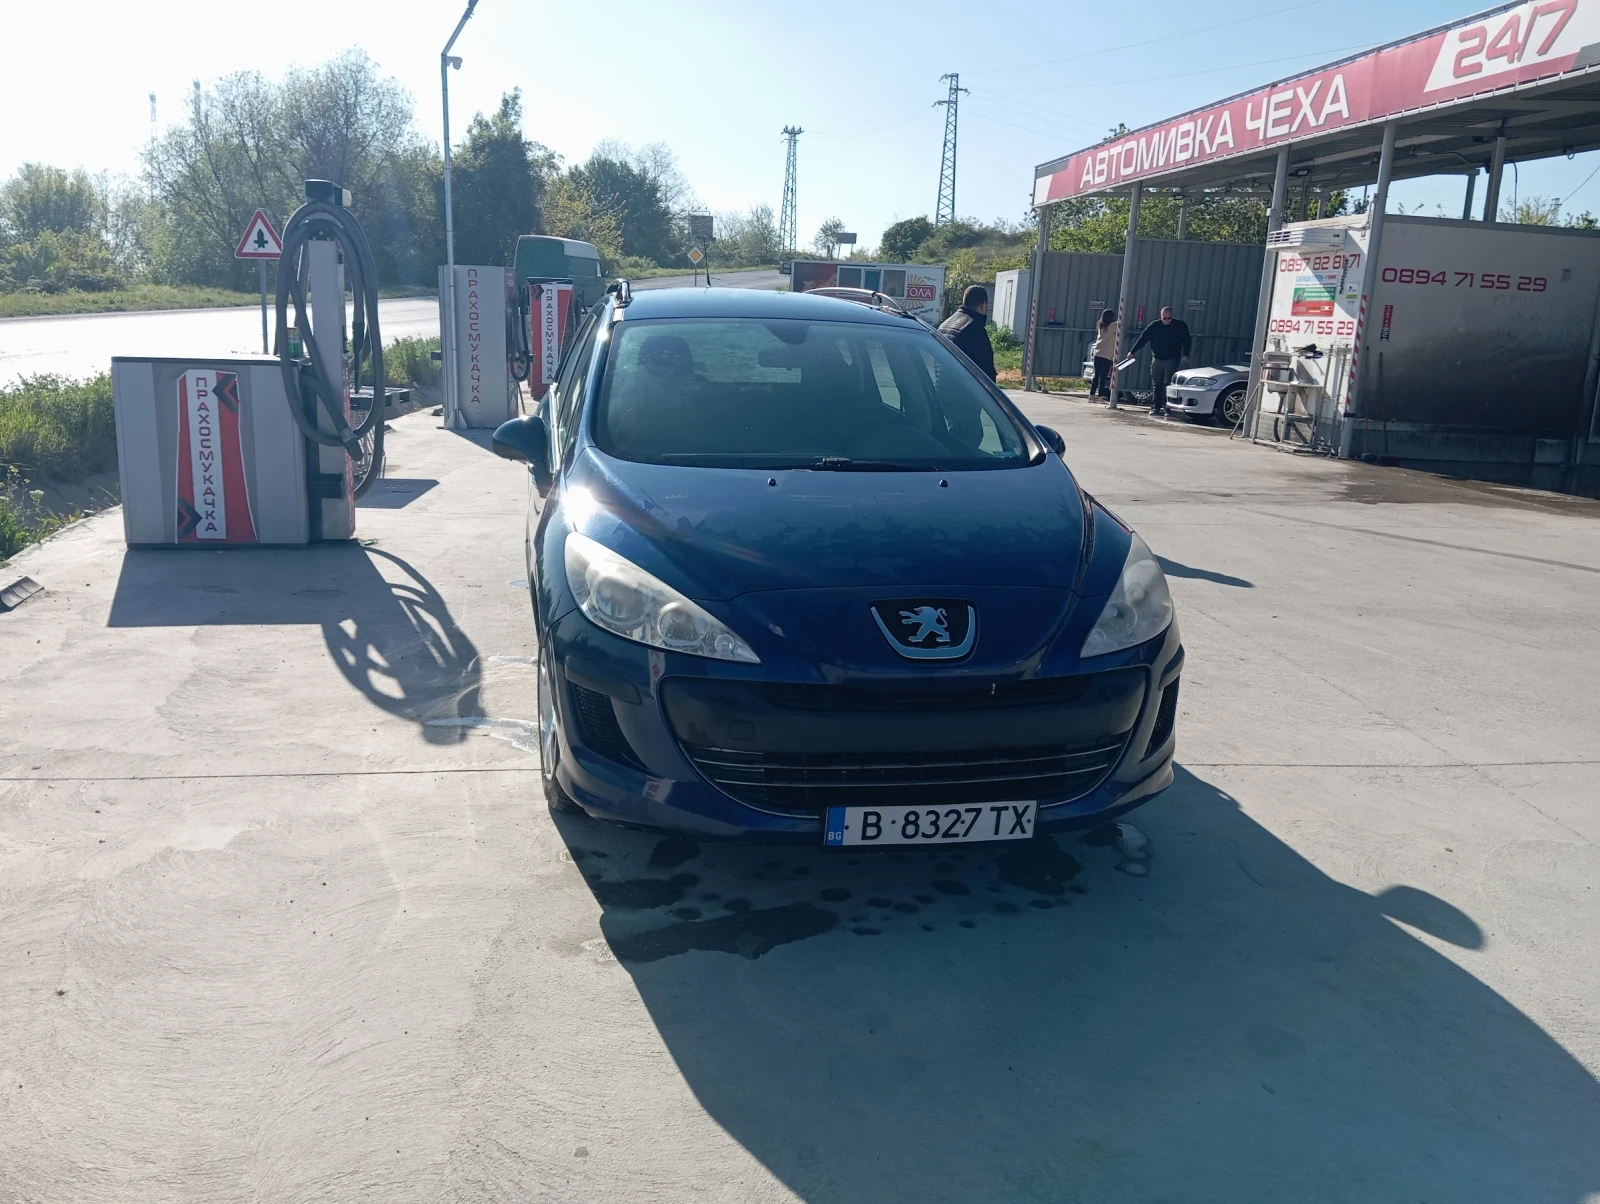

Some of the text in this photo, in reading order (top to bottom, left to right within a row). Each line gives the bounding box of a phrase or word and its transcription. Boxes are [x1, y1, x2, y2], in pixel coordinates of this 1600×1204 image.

[1452, 0, 1578, 79] 24/7
[1079, 73, 1350, 189] АВТОМИВКА ЧЕХА
[1280, 257, 1311, 273] 0897
[1312, 256, 1330, 271] 82
[1348, 253, 1361, 269] 71
[1381, 267, 1548, 293] 0894 71 55 29
[467, 268, 481, 404] ПРАХОСМУКАЧКА
[545, 288, 555, 381] ПРАХОСМУКАЧКА
[1270, 319, 1355, 336] 0894 71 55 29
[195, 376, 218, 532] ПРАХОСМУКАЧКА
[827, 831, 842, 841] BG
[860, 804, 1031, 841] B 8327 TX
